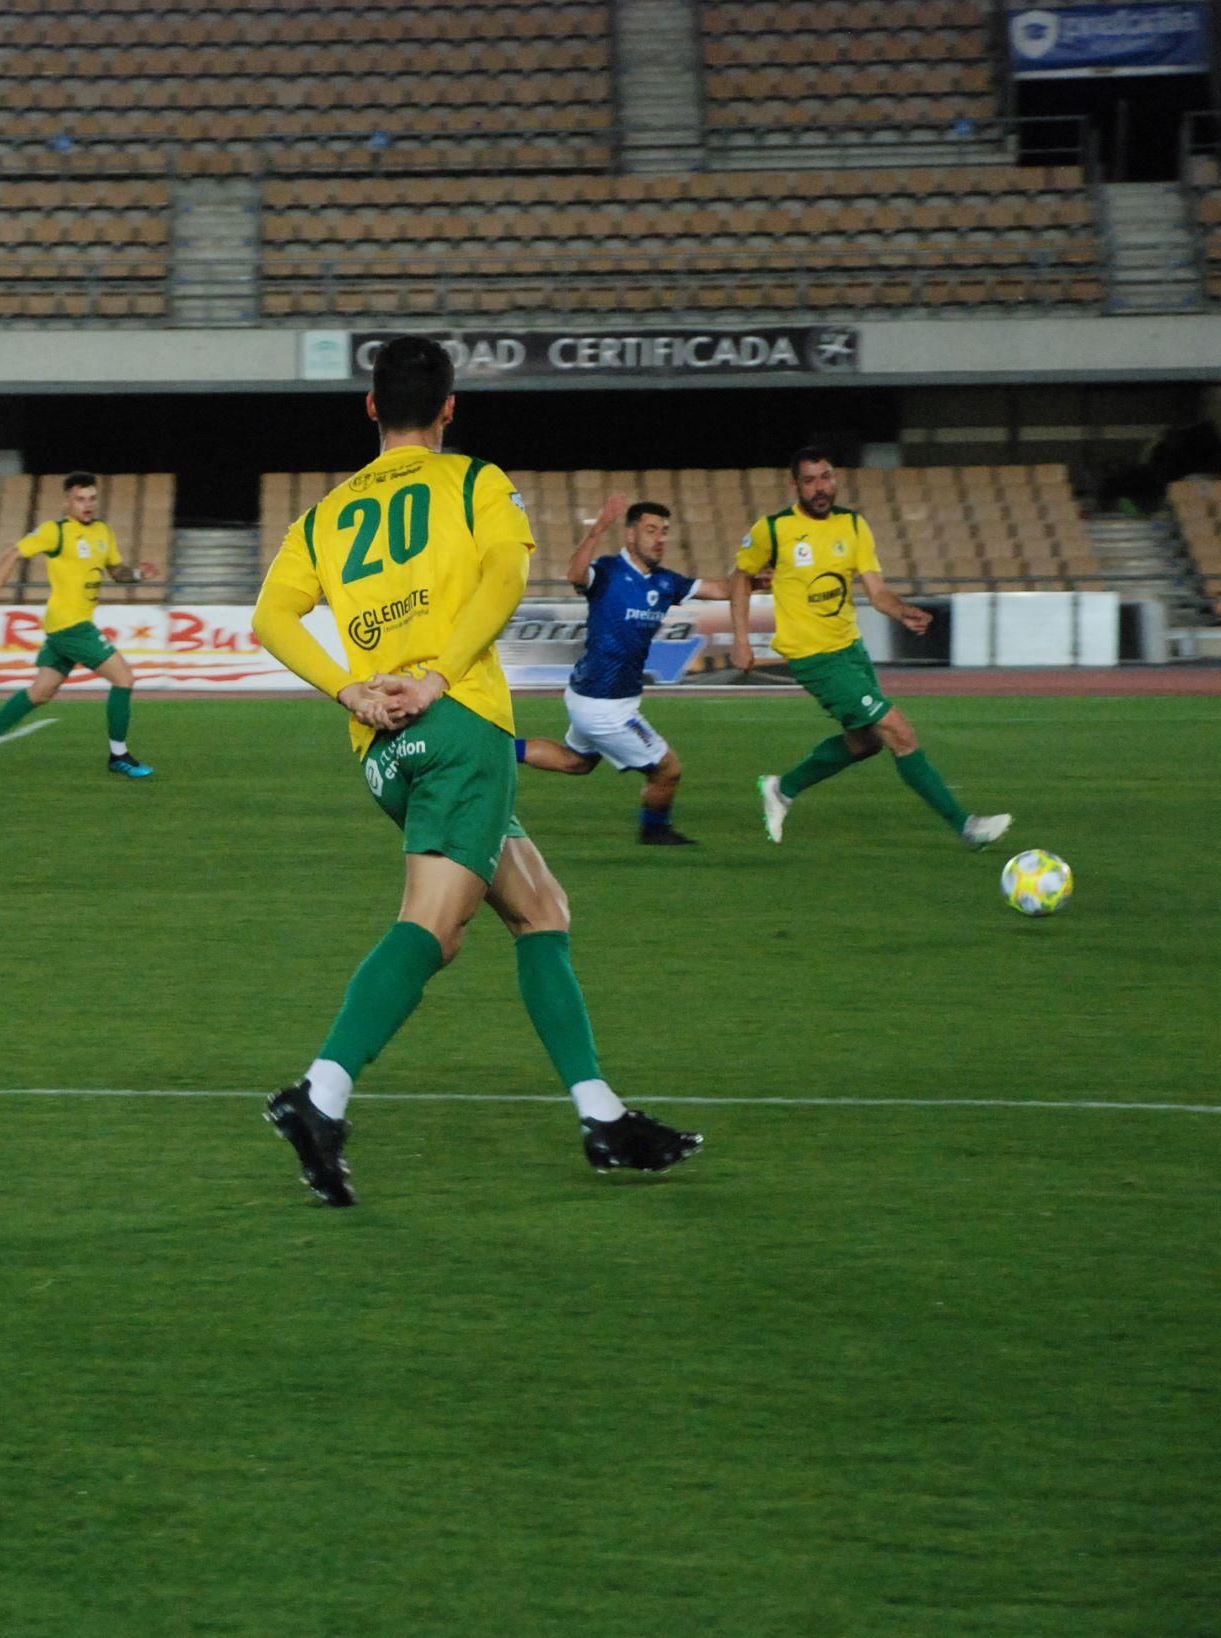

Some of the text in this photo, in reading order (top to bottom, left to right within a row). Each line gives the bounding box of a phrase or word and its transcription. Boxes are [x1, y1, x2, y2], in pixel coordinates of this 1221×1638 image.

[547, 336, 799, 371] CERTIFICADA
[337, 483, 430, 584] 20
[363, 588, 430, 628] CLEMENTE
